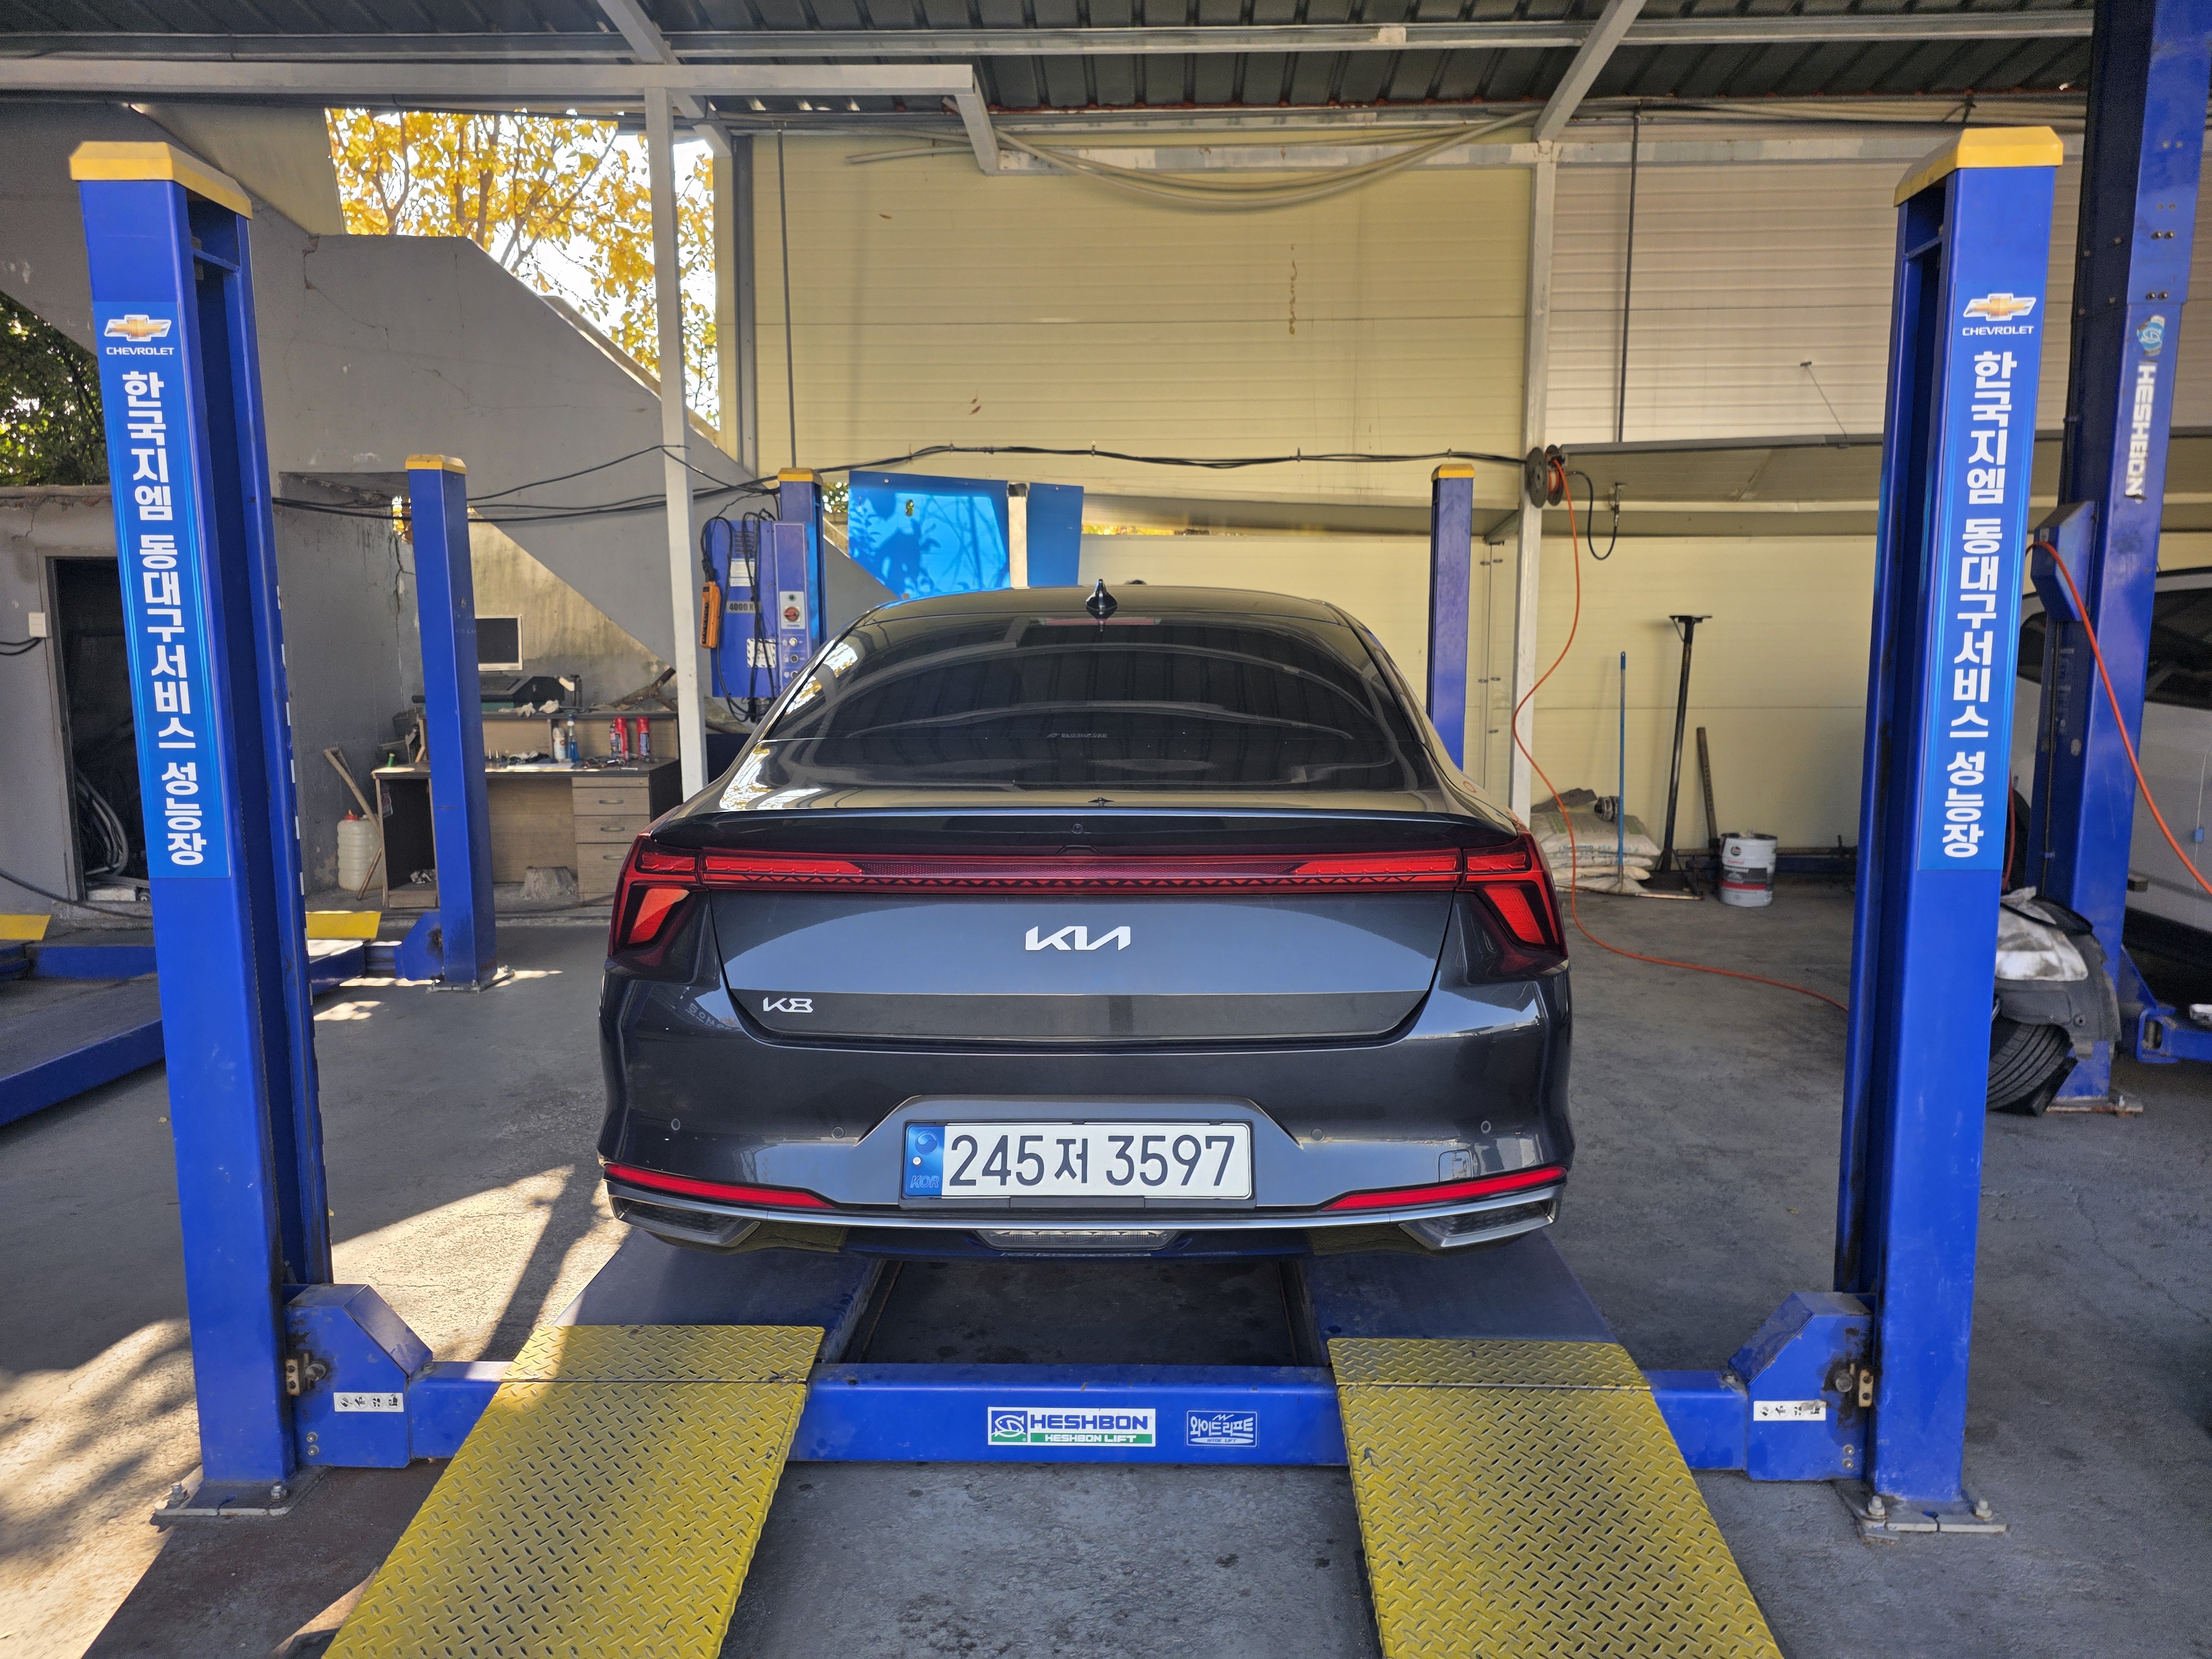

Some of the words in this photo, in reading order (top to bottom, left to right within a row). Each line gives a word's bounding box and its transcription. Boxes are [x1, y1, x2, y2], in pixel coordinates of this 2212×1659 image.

[1962, 325, 2034, 336] CHEVROLET
[106, 347, 175, 356] CHEVROLET
[1966, 351, 2017, 505] 한국지엠
[2125, 365, 2156, 496] HESHBON
[122, 371, 173, 521] 한국지엠
[729, 603, 747, 611] 4000
[1950, 518, 2002, 738] 동대구서비스
[139, 535, 196, 748] 동대구서비스
[161, 762, 207, 865] 성능장
[1942, 751, 1985, 858] 성능장
[1025, 926, 1131, 951] KIA
[763, 997, 813, 1013] K8
[949, 1134, 1088, 1186] 245저
[1106, 1134, 1235, 1186] 3597
[910, 1175, 940, 1188] KOR
[1030, 1414, 1148, 1430] HESHBON
[1190, 1415, 1254, 1438] 와이드리프트
[1045, 1434, 1102, 1443] HESHBON
[1104, 1434, 1137, 1443] LIFT
